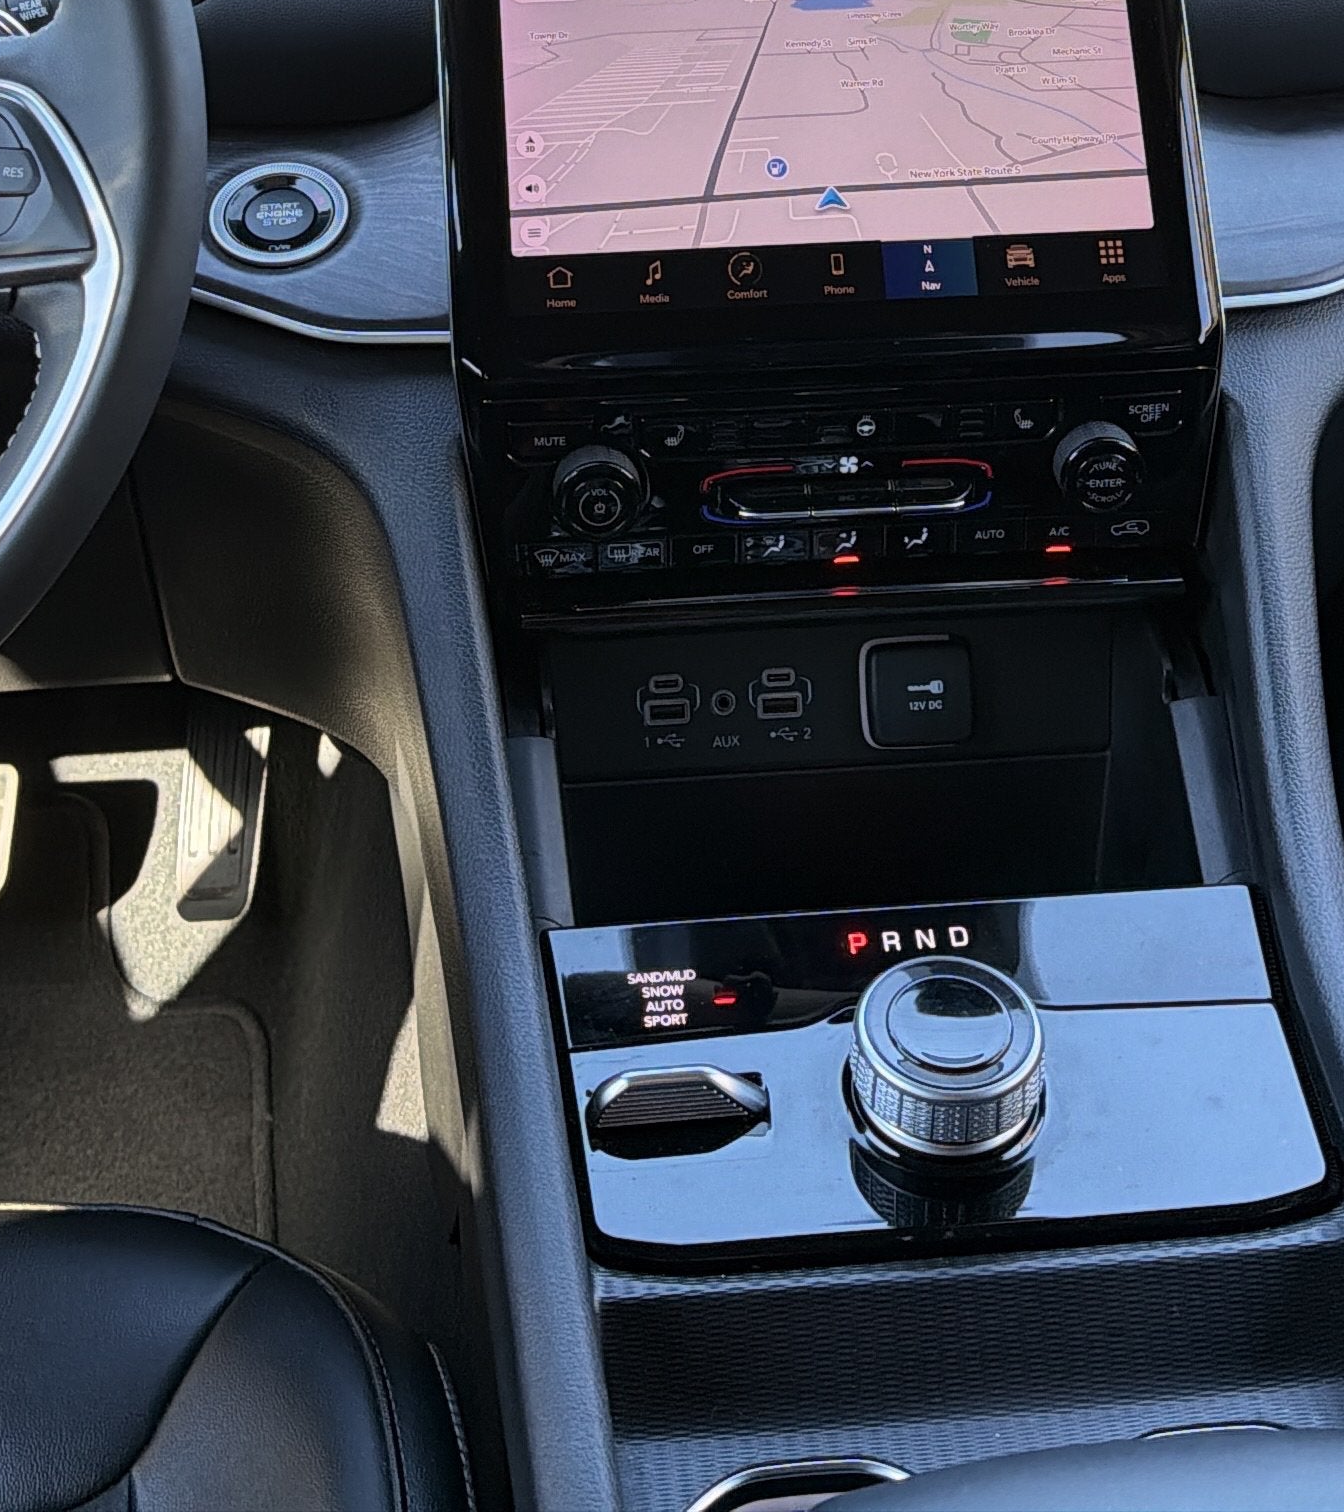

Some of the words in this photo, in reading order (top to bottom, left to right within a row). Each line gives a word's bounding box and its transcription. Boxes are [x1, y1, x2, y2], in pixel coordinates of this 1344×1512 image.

[19, 0, 42, 12] REAR
[19, 7, 49, 21] WIPER
[982, 23, 999, 32] Way
[530, 32, 554, 41] Towne
[847, 38, 867, 46] Sims
[785, 40, 819, 50] Kennedy
[821, 39, 832, 47] St
[1052, 47, 1090, 56] Mechanic
[1092, 47, 1102, 55] St
[996, 66, 1014, 74] Pratt
[1016, 65, 1027, 73] Ln
[840, 79, 869, 88] Warner
[871, 78, 884, 87] Rd
[1042, 77, 1050, 85] W
[1052, 76, 1065, 85] Elm
[1067, 76, 1077, 84] St
[1031, 136, 1061, 145] County
[1063, 135, 1099, 144] Highway
[1101, 133, 1117, 141] 109
[2, 167, 24, 178] RES
[910, 170, 931, 179] New
[932, 168, 956, 177] York
[958, 167, 982, 176] State
[984, 167, 1012, 175] Route
[1014, 165, 1021, 174] 5
[260, 202, 300, 211] START
[256, 209, 303, 219] ENGINE
[262, 217, 297, 226] STOP
[923, 245, 932, 254] N
[1005, 276, 1040, 287] Vehicle
[1102, 272, 1127, 283] Apps
[824, 284, 855, 295] Phone
[921, 280, 941, 291] Nav
[639, 293, 670, 304] Media
[727, 289, 768, 300] Comfort
[547, 298, 576, 308] Home
[1128, 403, 1170, 415] SCREEN
[1140, 413, 1163, 423] OFF
[534, 436, 567, 447] MUTE
[1093, 461, 1118, 471] TUNE
[1089, 479, 1123, 488] ENTER
[1089, 490, 1124, 503] SCROLL
[974, 529, 1005, 540] AUTO
[1049, 526, 1070, 536] A/C
[631, 547, 660, 558] REAR
[693, 545, 715, 554] OFF
[559, 552, 586, 563] MAX
[909, 700, 925, 711] 12V
[926, 700, 943, 710] DC
[803, 728, 812, 739] 2
[644, 737, 650, 748] 1
[712, 735, 740, 748] AUX
[847, 932, 868, 955] P
[881, 931, 902, 952] R
[915, 928, 936, 949] N
[948, 926, 969, 948] D
[627, 969, 696, 984] SAND/MUD
[641, 984, 684, 998] SNOW
[645, 998, 685, 1013] AUTO
[643, 1013, 689, 1028] SPORT
